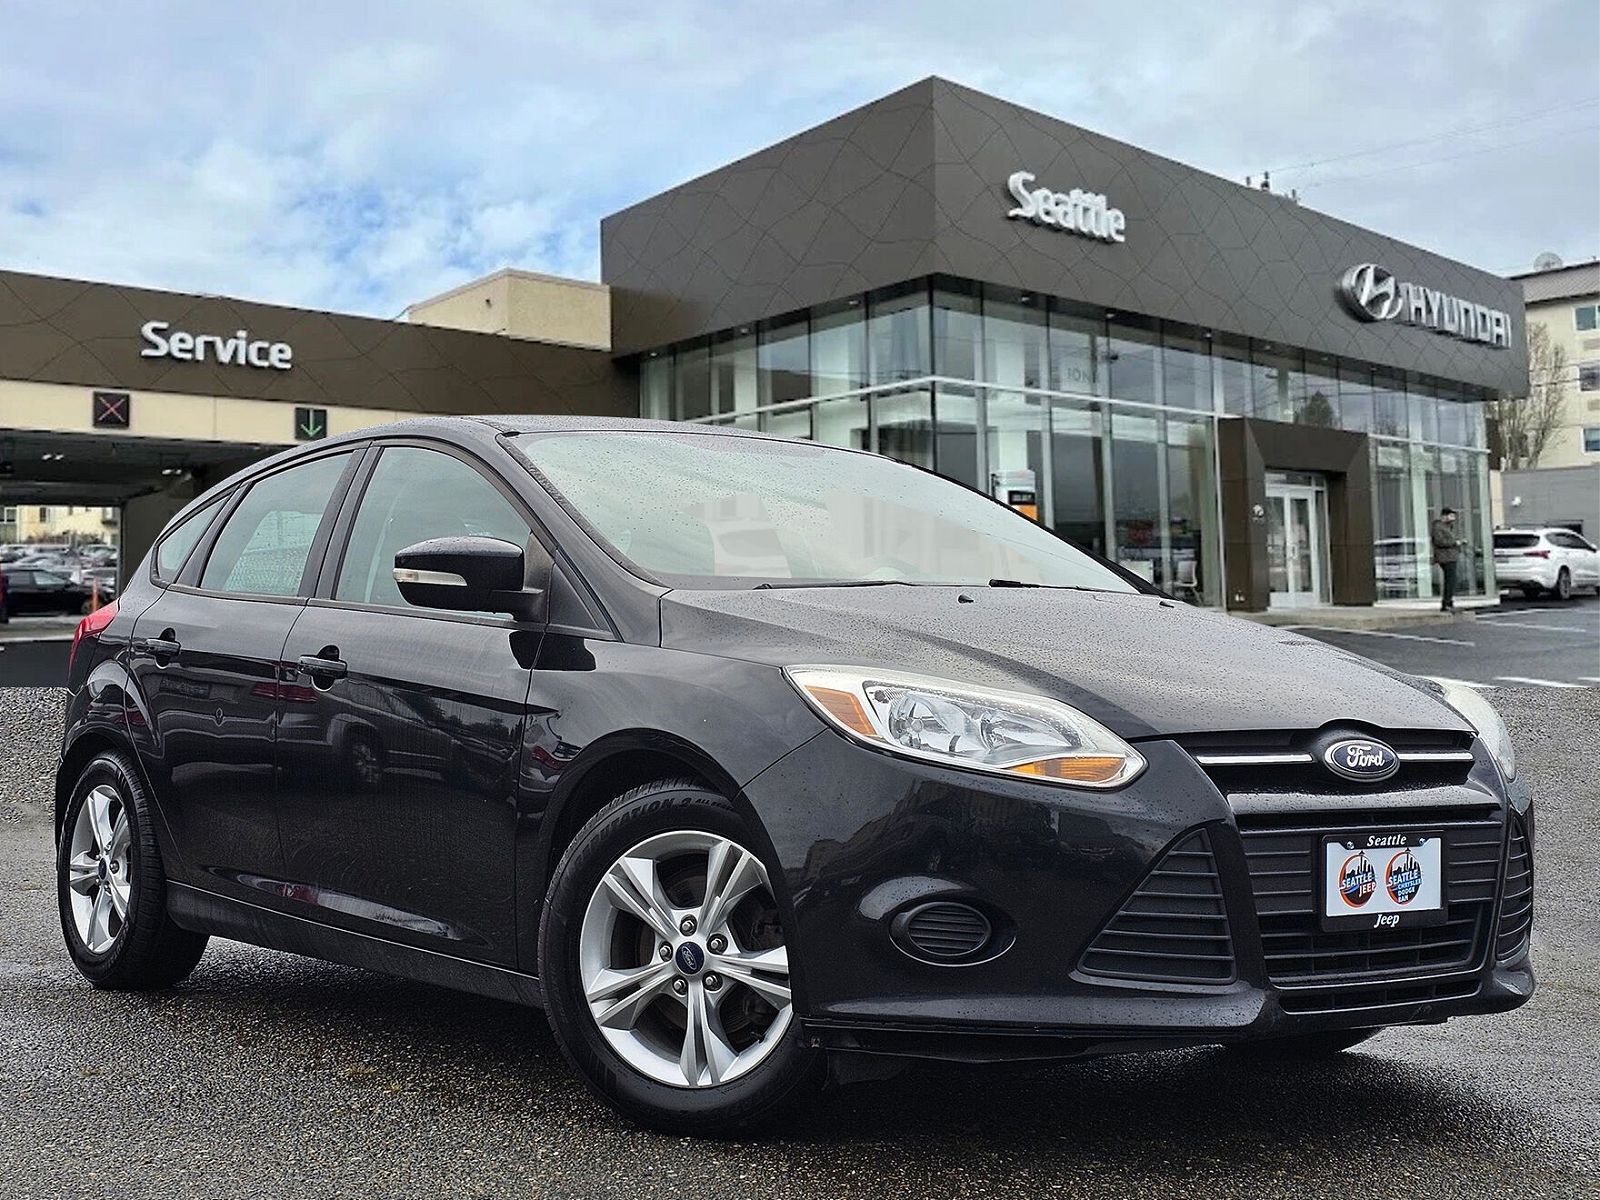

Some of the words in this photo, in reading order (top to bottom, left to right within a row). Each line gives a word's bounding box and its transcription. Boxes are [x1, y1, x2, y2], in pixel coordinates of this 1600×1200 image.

[1007, 171, 1125, 242] Seattle
[1401, 282, 1512, 348] HYUNDAI
[141, 320, 292, 369] Service
[1346, 745, 1386, 767] Ford
[1367, 834, 1407, 847] Seattle
[1340, 871, 1372, 890] SEATTLE
[1387, 869, 1418, 887] SEATTLE
[1358, 882, 1376, 897] JEEP
[1397, 887, 1415, 896] DODGE
[1374, 914, 1400, 928] Jeep
